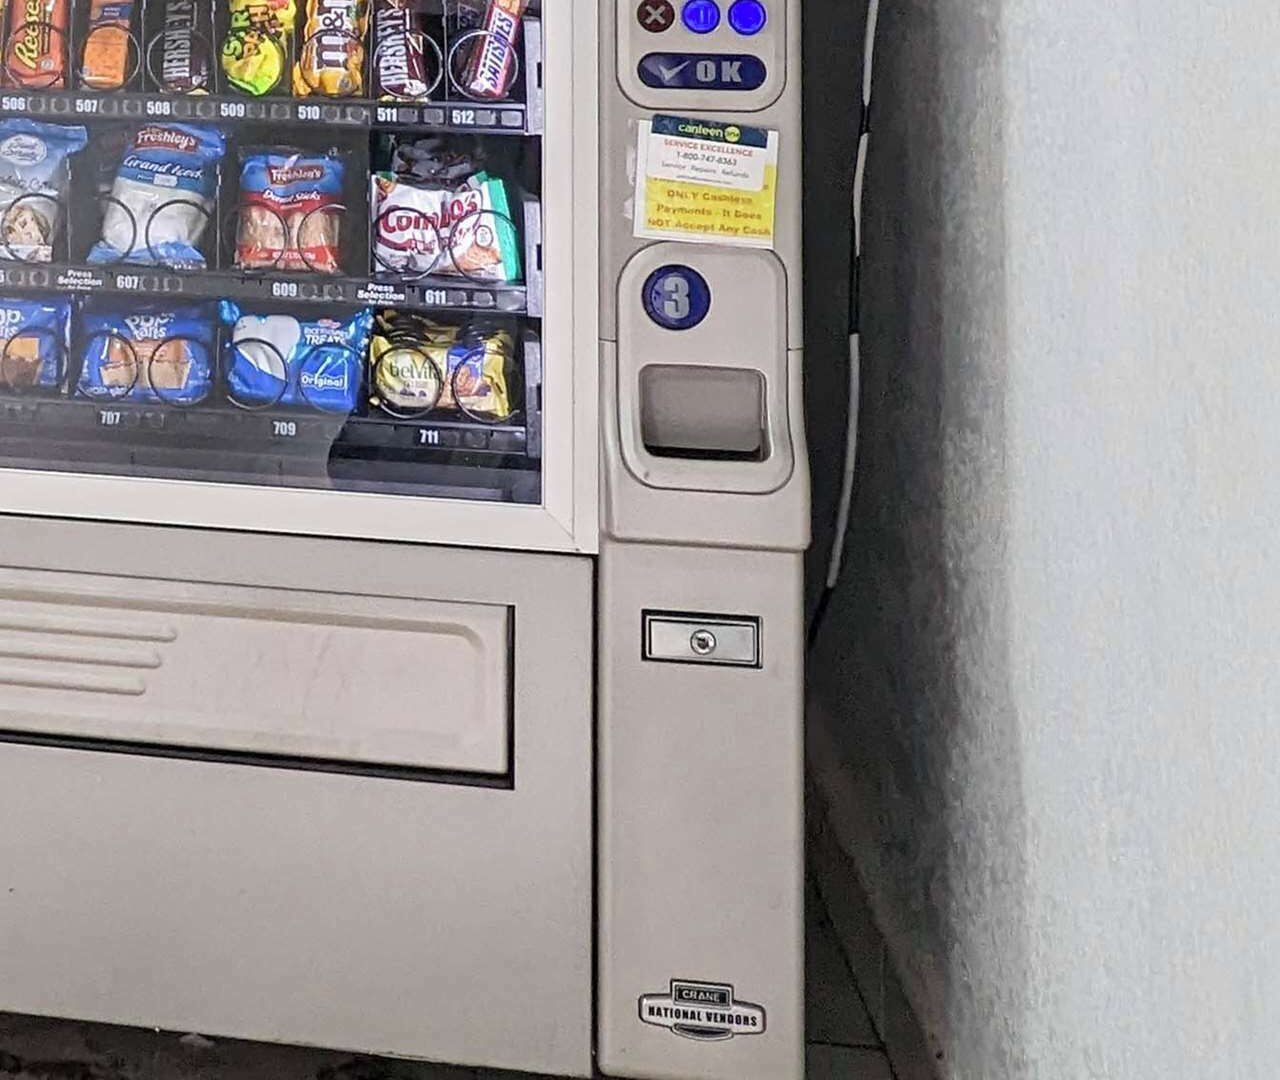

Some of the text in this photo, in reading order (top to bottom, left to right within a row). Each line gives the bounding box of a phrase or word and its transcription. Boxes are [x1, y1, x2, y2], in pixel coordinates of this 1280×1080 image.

[695, 60, 743, 83] OK
[2, 97, 25, 111] 506
[76, 100, 98, 113] 507
[147, 102, 170, 115] 508
[221, 104, 245, 117] 509
[298, 106, 320, 120] 510
[377, 108, 398, 122] 511
[452, 110, 475, 125] 512
[678, 123, 724, 138] canteen
[663, 138, 753, 157] SERVICE EXCELLENCE
[122, 155, 168, 173] Grand
[666, 189, 753, 204] ONLY Cashless
[656, 203, 712, 216] Payments
[734, 210, 762, 220] Does
[648, 218, 771, 236] NOT Accept Any Cash
[116, 275, 139, 289] 607
[272, 283, 297, 297] 609
[663, 276, 690, 319] 3
[301, 375, 344, 389] Original
[100, 410, 121, 424] 707
[273, 421, 296, 436] 709
[420, 429, 439, 444] 711
[681, 989, 720, 1002] CRANE
[648, 1005, 757, 1027] NATIONAL VENDORS
